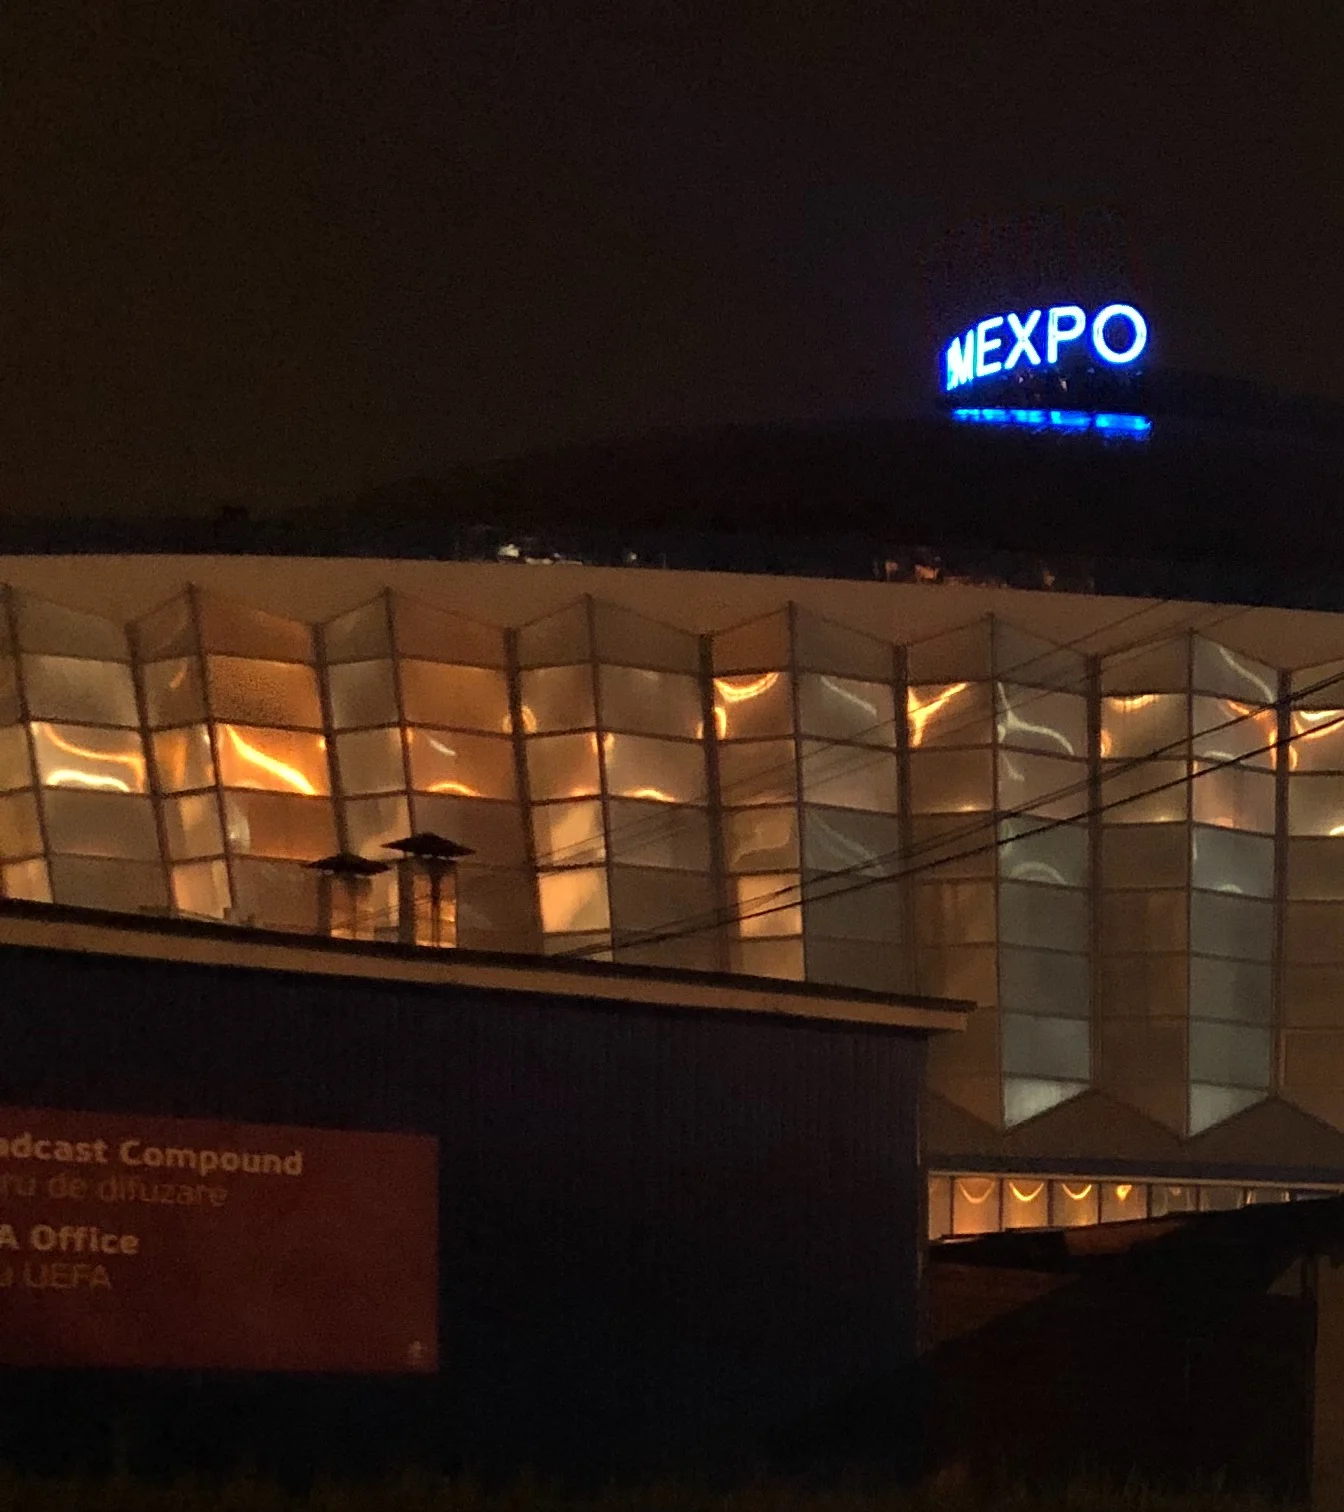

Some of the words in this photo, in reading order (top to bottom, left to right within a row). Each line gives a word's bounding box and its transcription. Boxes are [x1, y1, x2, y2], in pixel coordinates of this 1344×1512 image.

[946, 304, 1147, 391] MEXPO
[119, 1138, 304, 1177] Compound
[49, 1172, 88, 1200] de
[99, 1174, 229, 1207] difuzare
[30, 1223, 140, 1255] Office
[23, 1261, 112, 1291] UEFA
